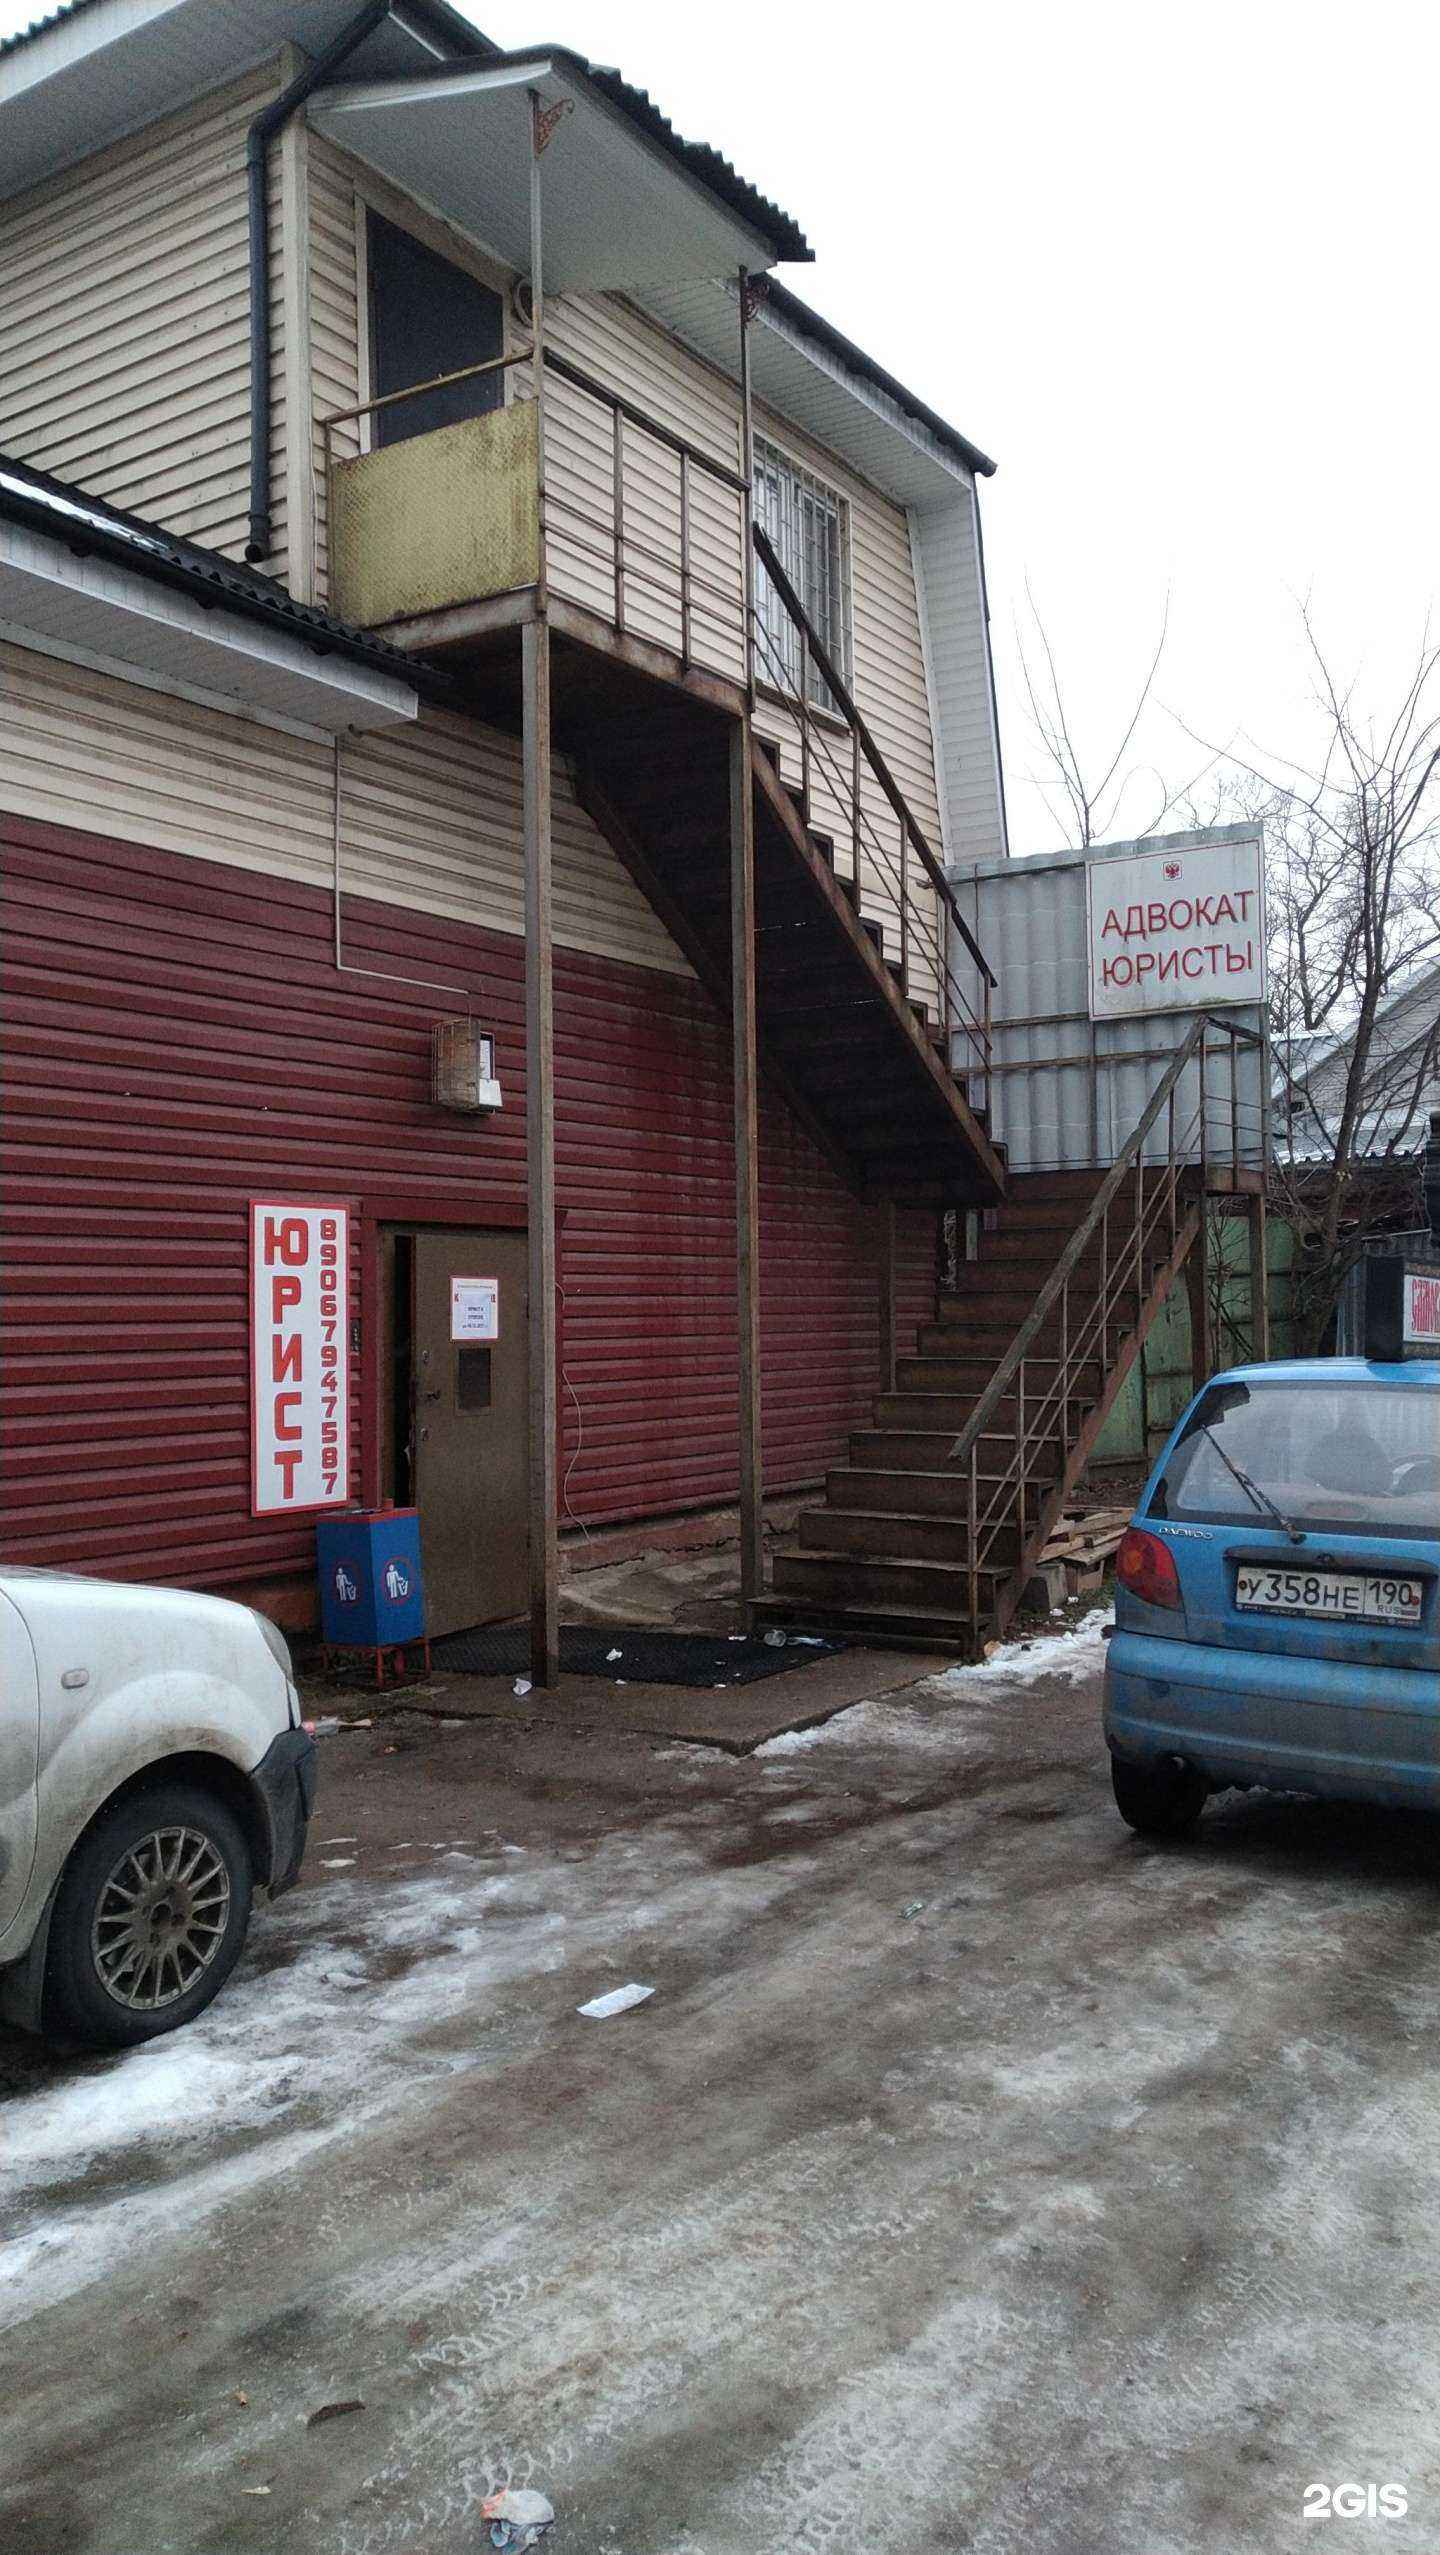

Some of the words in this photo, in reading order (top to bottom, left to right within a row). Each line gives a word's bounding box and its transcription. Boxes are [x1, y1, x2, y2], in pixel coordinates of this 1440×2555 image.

[1101, 890, 1254, 943] АДВОКАТ
[1102, 941, 1253, 987] ЮРИСТЫ
[263, 1216, 309, 1499] ЮРИСТ
[319, 1219, 338, 1495] 89067947587
[1368, 1580, 1412, 1606] 190
